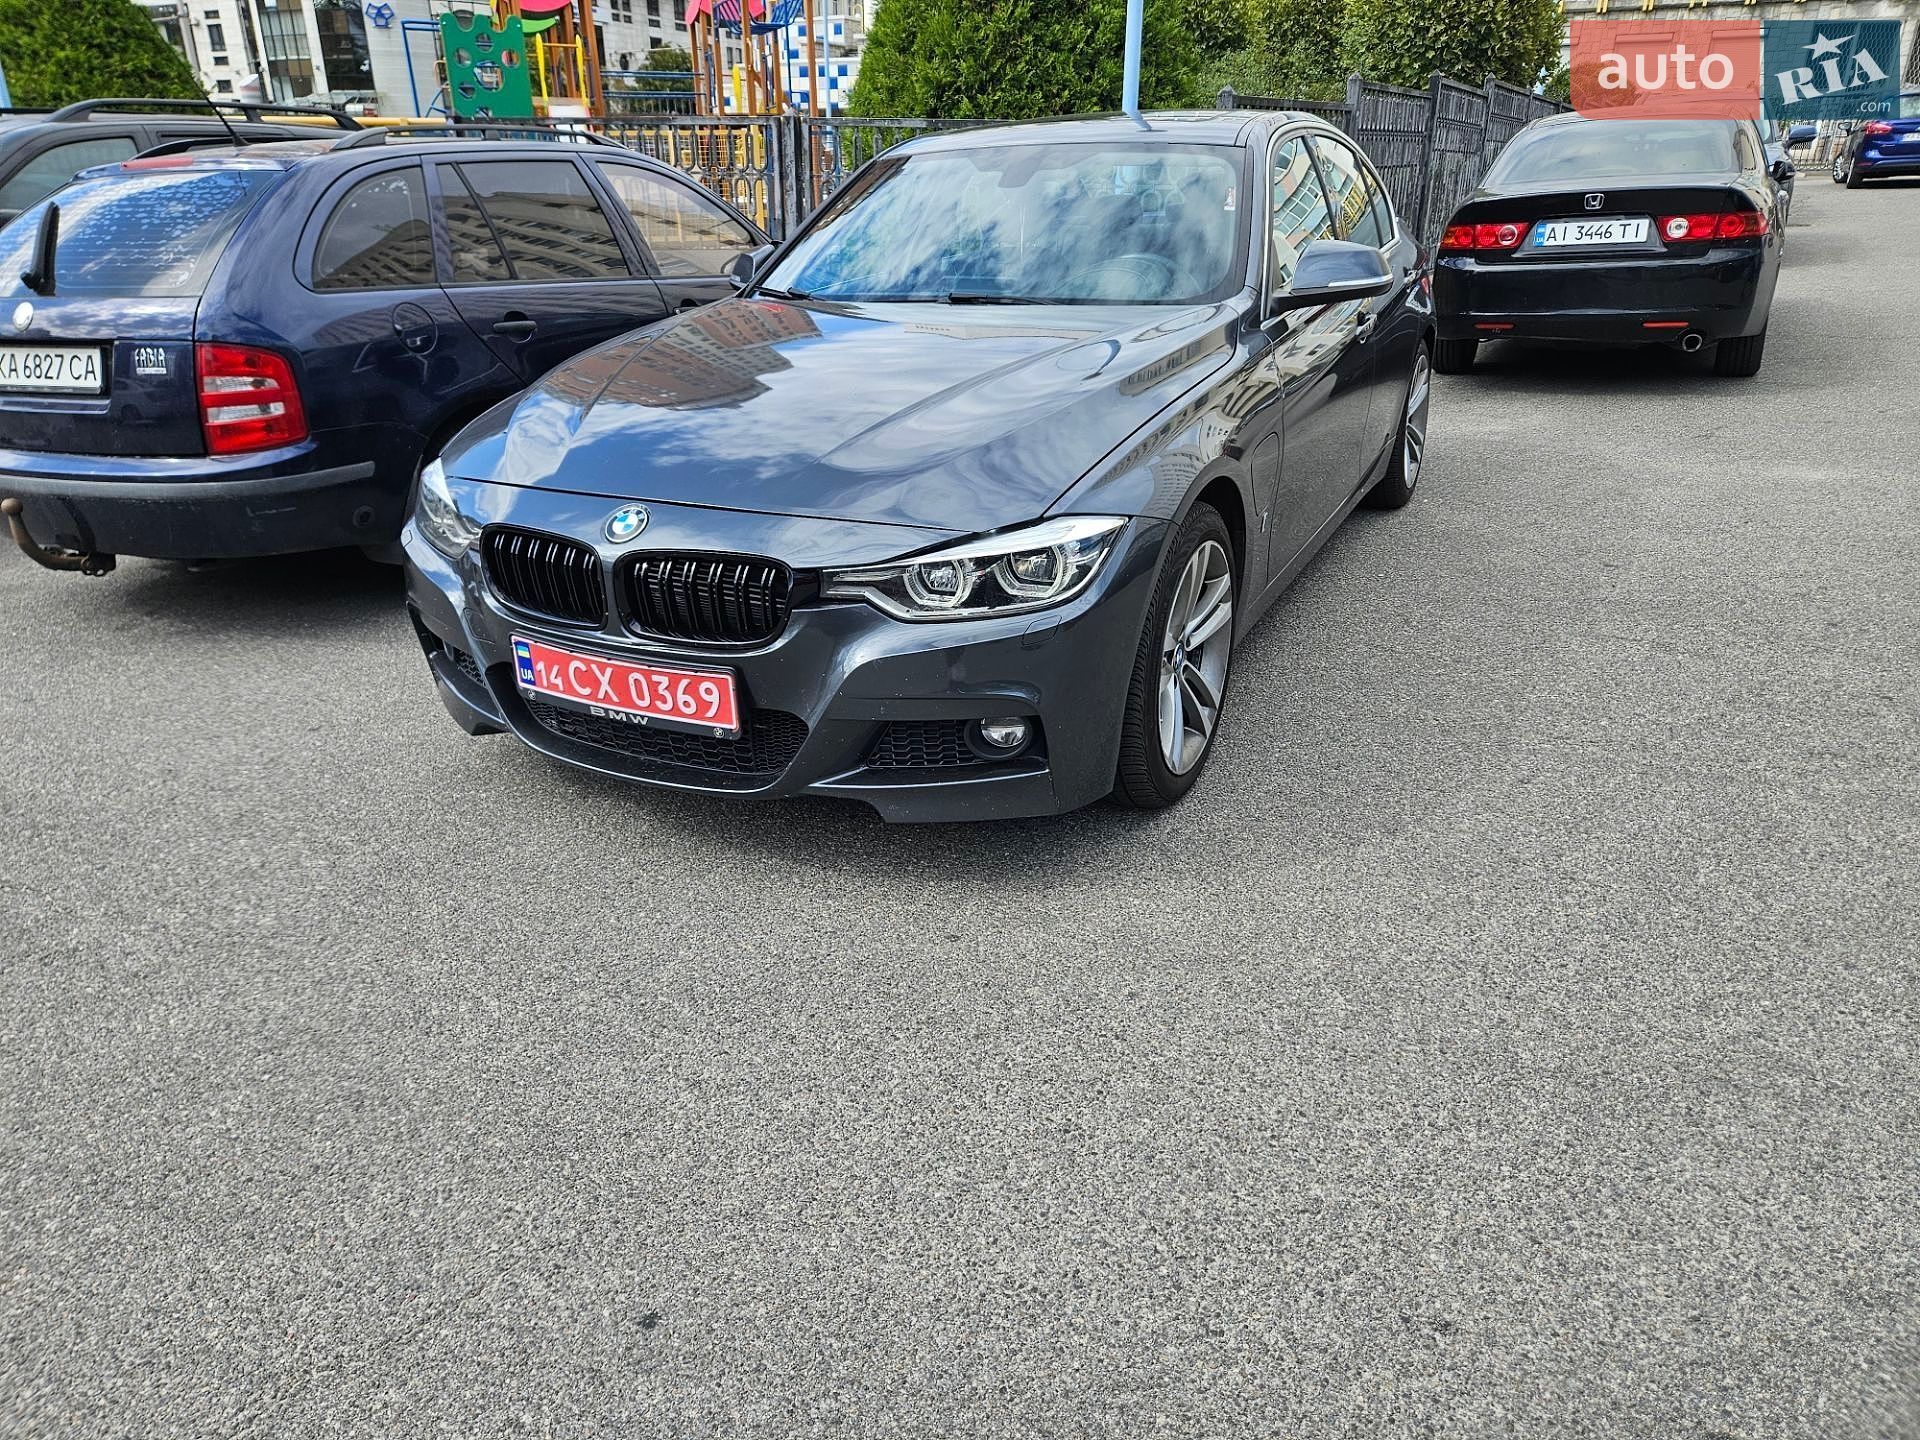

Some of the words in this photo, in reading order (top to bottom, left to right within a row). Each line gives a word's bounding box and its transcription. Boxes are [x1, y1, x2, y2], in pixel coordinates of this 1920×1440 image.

[1546, 226, 1568, 242] AI
[1574, 224, 1613, 241] 3446
[1619, 223, 1640, 239] TI
[23, 353, 65, 380] 6827
[69, 354, 97, 381] CA
[520, 667, 534, 681] UA
[627, 671, 720, 718] 0369
[589, 706, 648, 725] BMW
